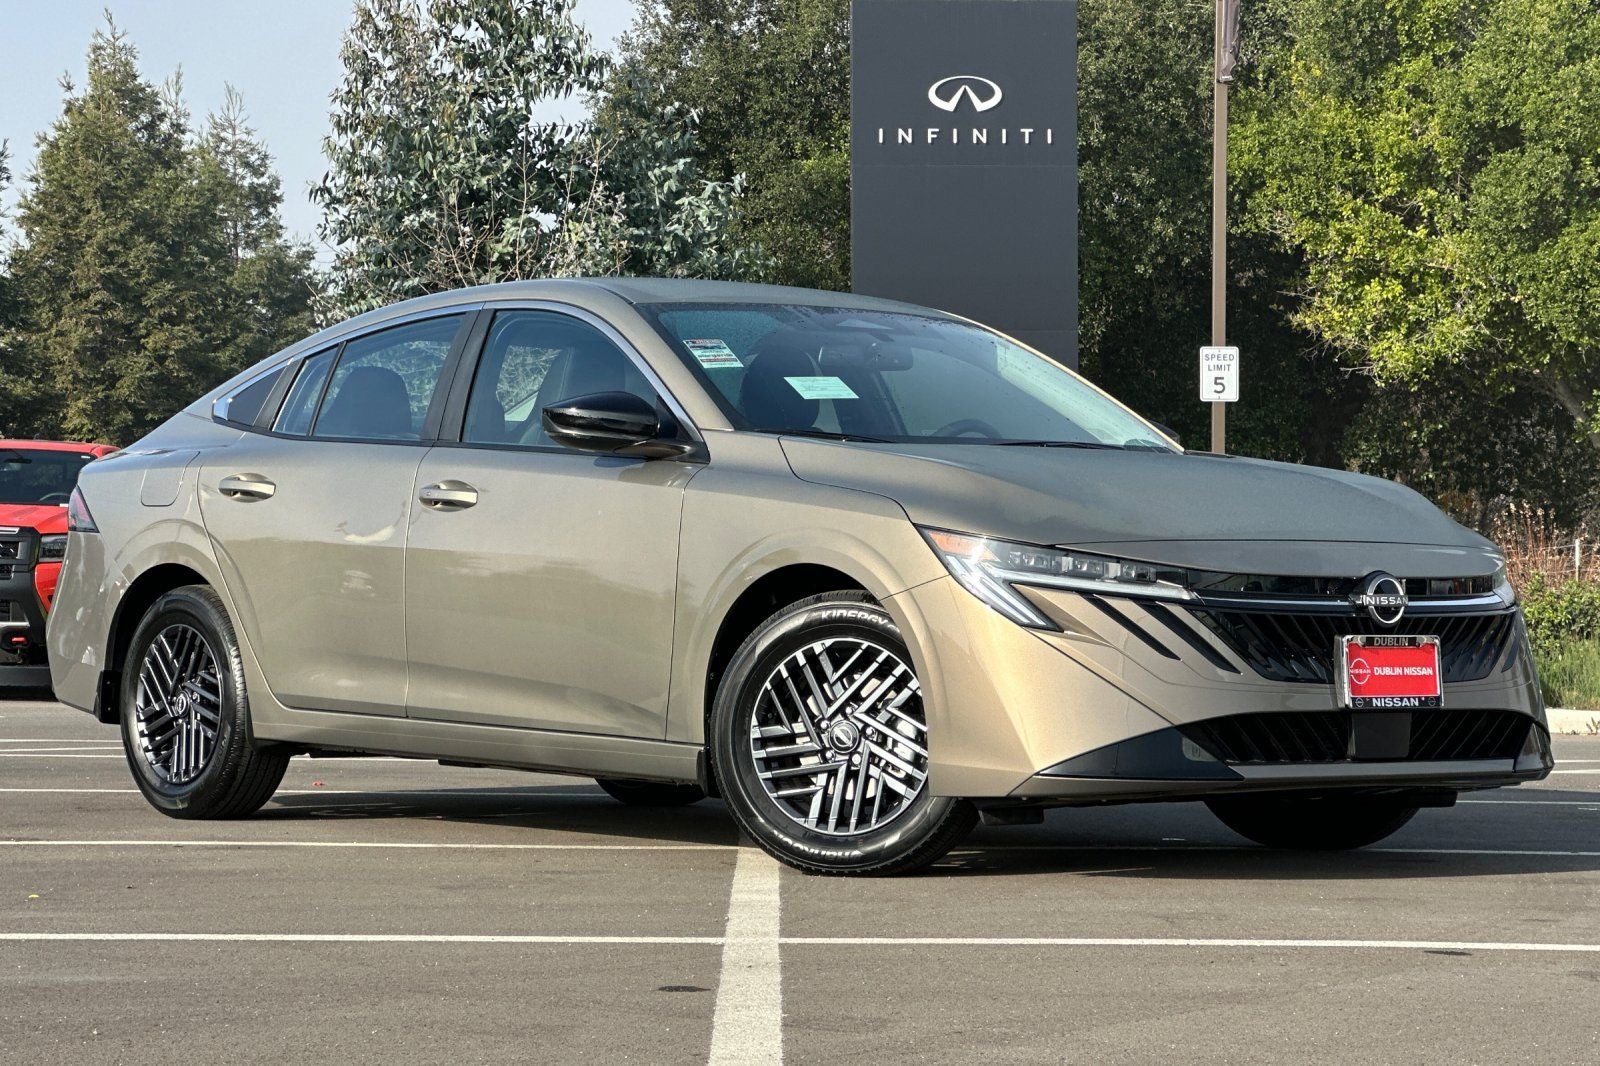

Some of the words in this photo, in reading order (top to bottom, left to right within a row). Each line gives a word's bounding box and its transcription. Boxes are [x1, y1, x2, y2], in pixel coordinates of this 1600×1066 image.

[878, 128, 1053, 144] INFINITI
[1204, 353, 1235, 362] SPEED
[1213, 376, 1226, 394] 5
[1366, 596, 1408, 605] NISSAN
[1373, 637, 1409, 646] DUBLIN
[1374, 667, 1403, 676] DUBLIN
[1404, 667, 1433, 676] NISSAN
[1372, 697, 1419, 707] NISSAN
